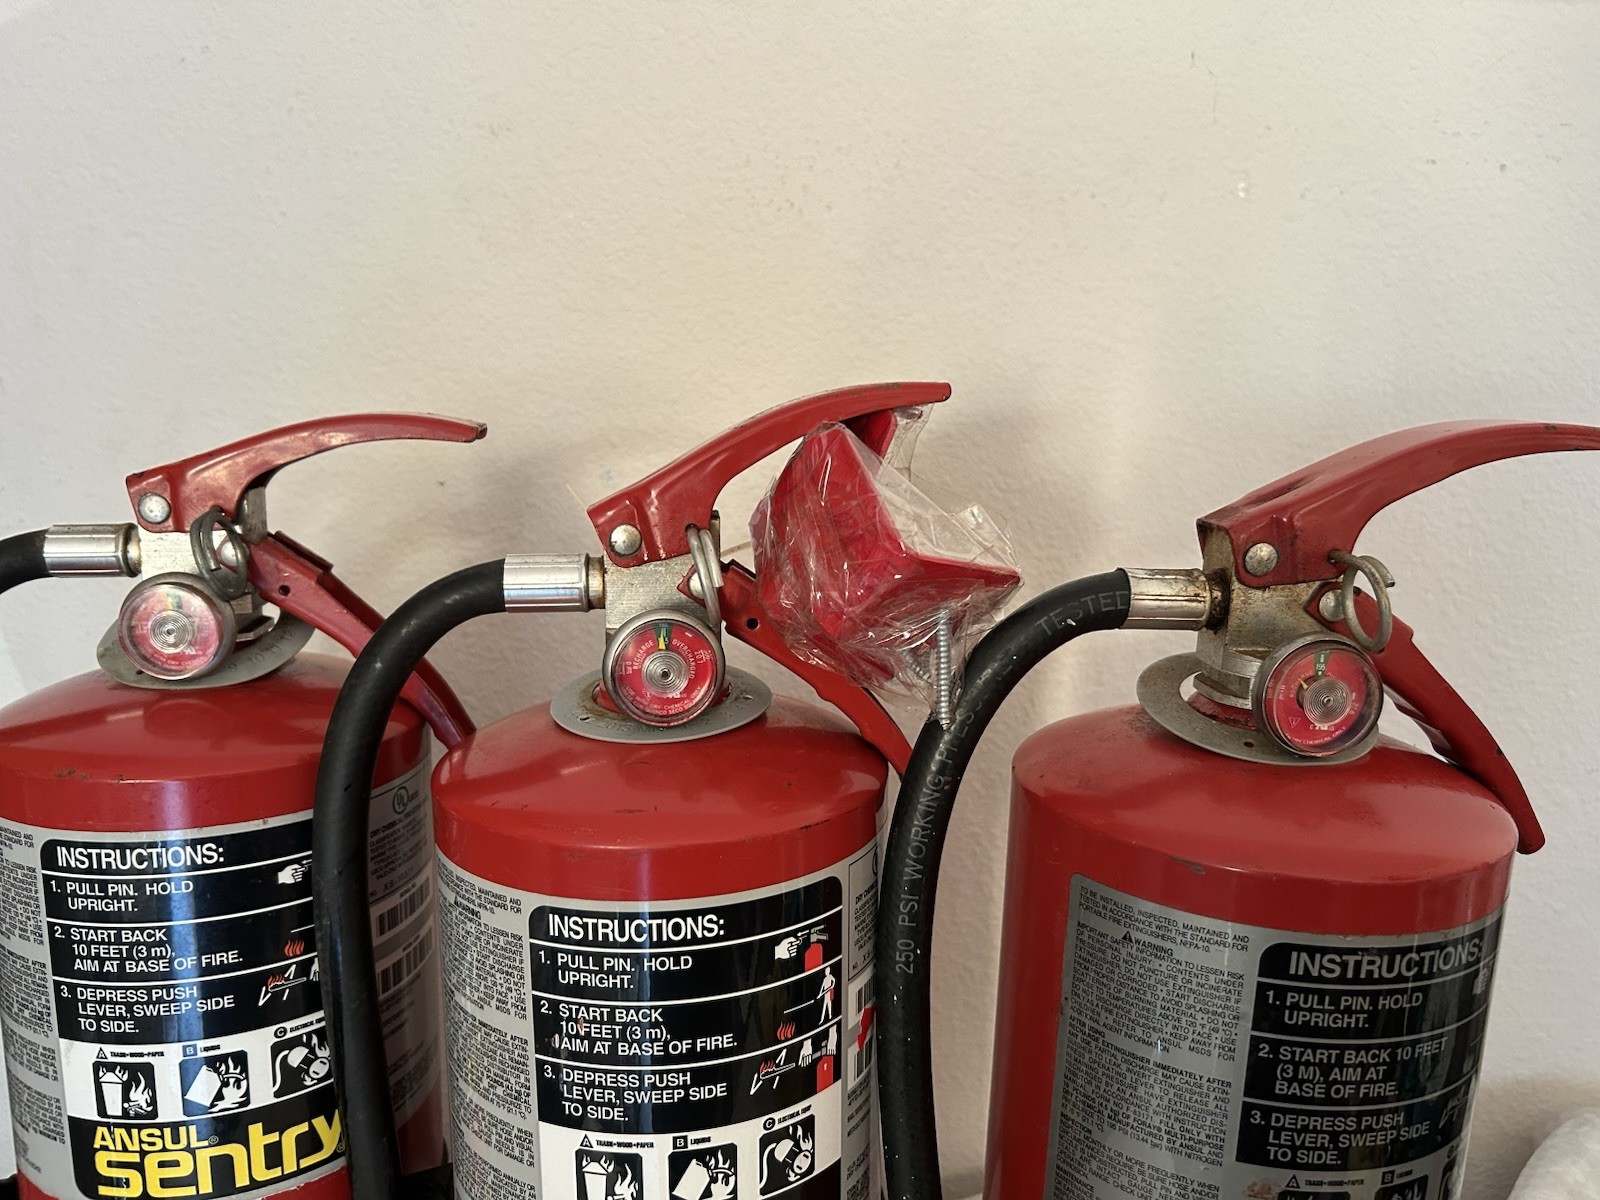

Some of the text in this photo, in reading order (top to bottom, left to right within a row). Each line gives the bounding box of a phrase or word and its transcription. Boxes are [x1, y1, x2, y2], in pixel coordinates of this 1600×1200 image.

[1034, 590, 1129, 636] TESTED
[633, 640, 654, 669] RECHARGE
[672, 639, 696, 679] OVERCHARGED
[903, 774, 945, 882] WORKING
[57, 843, 224, 870] INSTRUCTIONS:
[51, 880, 194, 896] 1. PULL PIN. HOLD
[68, 897, 138, 911] UPRIGHT.
[898, 891, 919, 928] PSI
[1080, 885, 1250, 943] TO BE INSTALLED, INSPECTED, MAINTAINED AND
[549, 914, 724, 942] INSTRUCTIONS:
[1079, 893, 1101, 908] TESTED
[1109, 906, 1153, 928] ACCORDANCE
[1155, 923, 1173, 935] WITH
[1174, 929, 1188, 939] THE
[1190, 933, 1230, 948] STANDARD
[1232, 943, 1248, 952] FOR
[1079, 903, 1211, 953] PORTABLE FIRE EXTINGUISHERS, NFPA-10.
[54, 926, 167, 942] 2. START BACK
[72, 944, 175, 960] 10 FEET (3 m),
[894, 938, 915, 975] 250
[1134, 937, 1173, 957] WARNING
[74, 950, 243, 973] AIM AT BASE OF FIRE.
[539, 950, 692, 972] 1. PULL PIN. HOLD
[1289, 938, 1483, 979] INSTRUCTIONS:
[558, 971, 634, 989] UPRIGHT.
[1166, 964, 1244, 989] CONTENTS UNDER
[1196, 964, 1244, 980] LESSEN RISK
[60, 985, 197, 1002] 3. DEPRESS PUSH
[1195, 981, 1242, 997] INCINERATE
[78, 995, 235, 1019] LEVER, SWEEP SIDE
[541, 1000, 663, 1022] 2. START BACK
[1266, 990, 1423, 1011] 1. PULL PIN. HOLD
[78, 1018, 139, 1033] TO SIDE.
[1284, 1009, 1369, 1028] UPRIGHT.
[560, 1022, 671, 1042] 10 FEET (3 m),
[186, 1047, 194, 1055] B
[561, 1033, 737, 1056] AIM AT BASE OF FIRE.
[1258, 1037, 1448, 1064] 2. START BACK 10 FEET
[544, 1065, 691, 1087] 3. DEPRESS PUSH
[1153, 1060, 1232, 1089] IMMEDIATELY AFTER
[1276, 1063, 1387, 1083] (3 M), AIM AT
[563, 1083, 727, 1106] LEVER, SWEEP SIDE
[1275, 1080, 1399, 1098] BASE OF FIRE.
[562, 1101, 628, 1121] TO SIDE.
[1250, 1110, 1404, 1131] 3. DEPRESS PUSH
[517, 1127, 533, 1139] WHEN
[765, 1119, 773, 1128] C
[676, 1138, 685, 1146] B
[1268, 1121, 1431, 1149] LEVER, SWEEP SIDE
[1266, 1146, 1341, 1165] TO SIDE.
[1385, 1174, 1392, 1182] B
